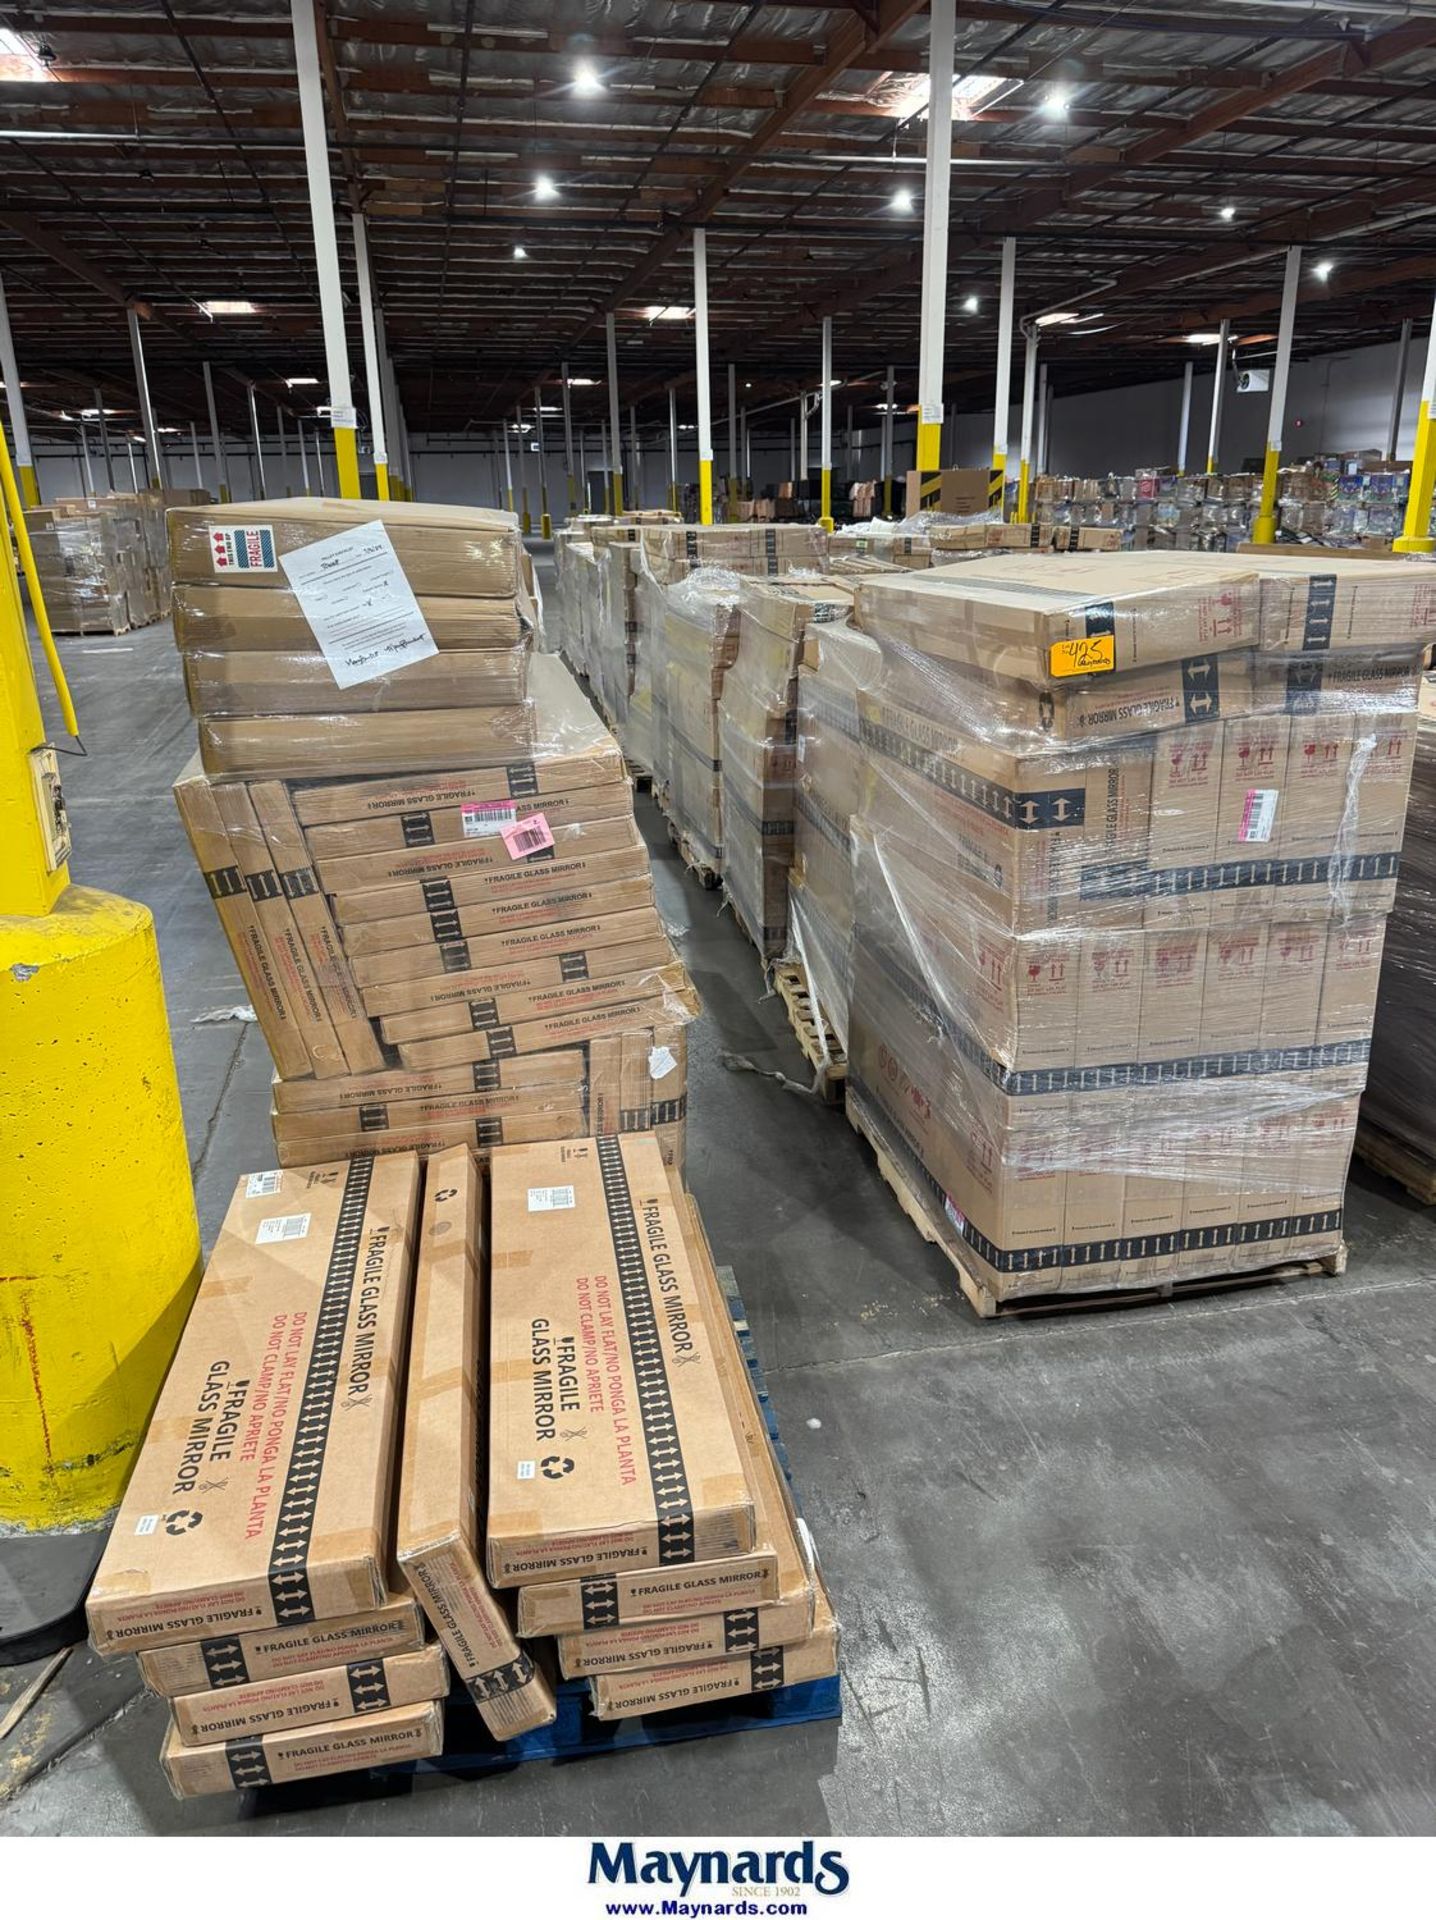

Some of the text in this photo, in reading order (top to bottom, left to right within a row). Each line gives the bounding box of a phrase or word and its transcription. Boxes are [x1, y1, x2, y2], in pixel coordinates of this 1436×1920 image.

[246, 531, 262, 567] FRAGILE
[1334, 669, 1360, 682] FRAGILE
[1362, 668, 1383, 681] GLASS
[1088, 711, 1117, 725] MIRROR
[1118, 705, 1143, 720] GLASS
[1107, 767, 1119, 797] MIRROR
[1106, 798, 1118, 825] GLASS
[488, 862, 581, 883] FRAGILE GLASS MIRROR
[495, 892, 588, 914] FRAGILE GLASS MIRROR
[505, 925, 596, 946] FRAGILE GLASS MIRROR
[250, 928, 285, 1016] FRAGILE GLASS MIRROR
[532, 981, 621, 1002] FRAGILE GLASS MIRROR
[548, 1007, 637, 1030] FRAGILE GLASS MIRROR
[643, 1207, 693, 1353] FRAGILE GLASS MIRROR
[348, 1233, 387, 1395] FRAGILE GLASS MIRROR
[576, 1278, 604, 1412] DO NOT CLAMP/NO APRIETE
[240, 1315, 287, 1461] DO NOT CLAMP/NO APRIETE
[531, 1318, 556, 1441] GLASS MIRROR
[557, 1344, 580, 1412] FRAGILE
[595, 1276, 636, 1485] DO NOT LAY FLAT/NO PONGA LA PLANTA
[173, 1360, 230, 1494] GLASS MIRROR
[210, 1389, 250, 1462] FRAGILE
[246, 1312, 307, 1539] DO NOT LAY FLAT/NO PONGA LA PLANTA
[513, 1548, 640, 1572] FRAGILE GLASS MIRROR
[418, 1569, 442, 1603] MIRROR
[638, 1571, 760, 1595] FRAGILE GLASS MIRROR
[117, 1609, 253, 1638] FRAGILE GLASS MIRROR
[437, 1603, 457, 1629] GLASS
[264, 1622, 394, 1652] FRAGILE GLASS MIRROR
[452, 1629, 476, 1662] FRAGILE
[584, 1642, 705, 1666] FRAGILE GLASS MIRROR
[616, 1679, 732, 1709] FRAGILE GLASS MIRROR
[202, 1701, 331, 1732] FRAGILE GLASS MIRROR
[286, 1745, 327, 1758] FRAGILE
[332, 1739, 365, 1751] GLASS
[370, 1731, 413, 1744] MIRROR
